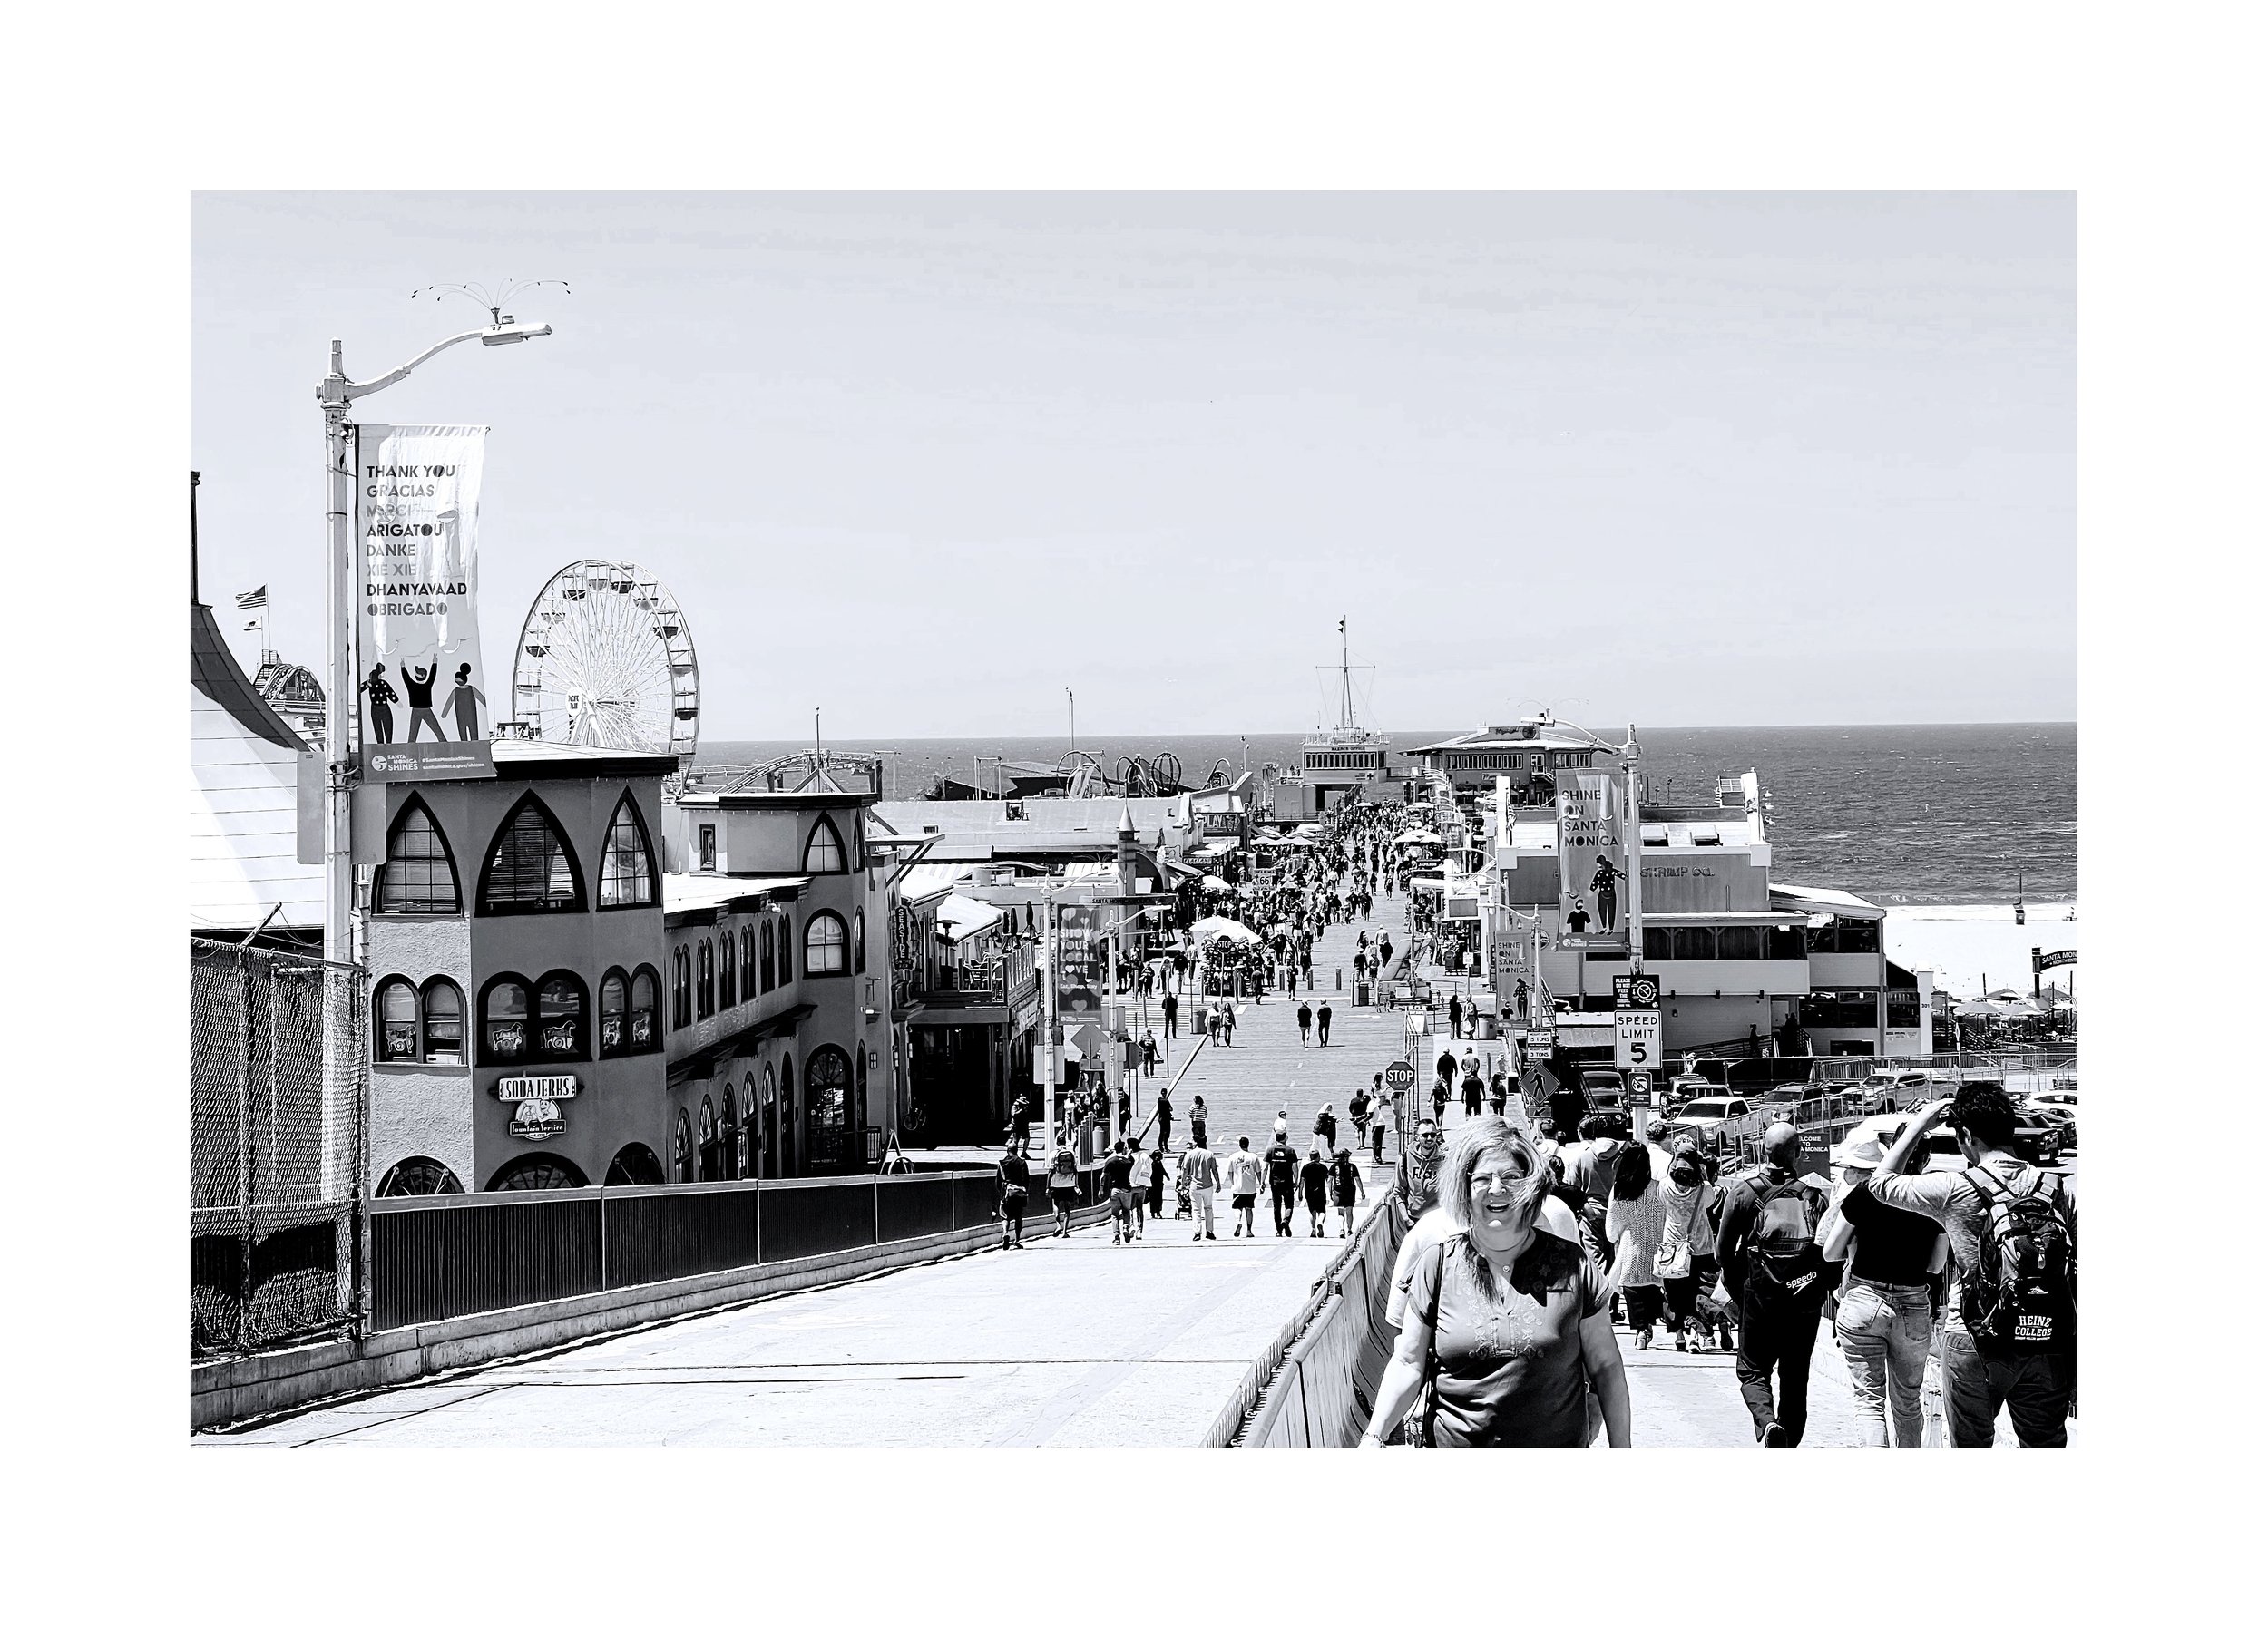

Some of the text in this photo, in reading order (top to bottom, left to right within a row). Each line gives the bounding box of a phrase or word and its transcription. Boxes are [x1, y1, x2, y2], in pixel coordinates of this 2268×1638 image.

[367, 465, 455, 478] THANK YOU
[367, 485, 435, 498] GRACIAS
[367, 523, 444, 537] ARIGATOU
[367, 544, 415, 557] DANKE
[367, 564, 416, 576] XIE XIE
[367, 583, 467, 596] DHANYAVAAD
[367, 603, 448, 616] OBRIGADO
[1562, 790, 1601, 800] SHINE
[1564, 804, 1584, 816] ON
[1564, 821, 1607, 832] SANTA
[1564, 835, 1618, 847] MONICA
[1259, 876, 1270, 885] 66
[1060, 929, 1093, 938] SHOW
[1060, 941, 1089, 950] YOUR
[1218, 940, 1231, 948] STOP
[1060, 952, 1097, 961] LOCAL
[2041, 953, 2061, 964] SANTA
[1618, 1016, 1657, 1026] SPEED
[1622, 1029, 1654, 1038] LIMIT
[1631, 1042, 1647, 1064] 5
[1387, 1070, 1414, 1082] STOP
[505, 1077, 570, 1098] SODA JERKS
[1785, 1271, 1817, 1289] speedo
[2019, 1315, 2053, 1328] HEINZ
[2014, 1325, 2053, 1337] COLLEGE
